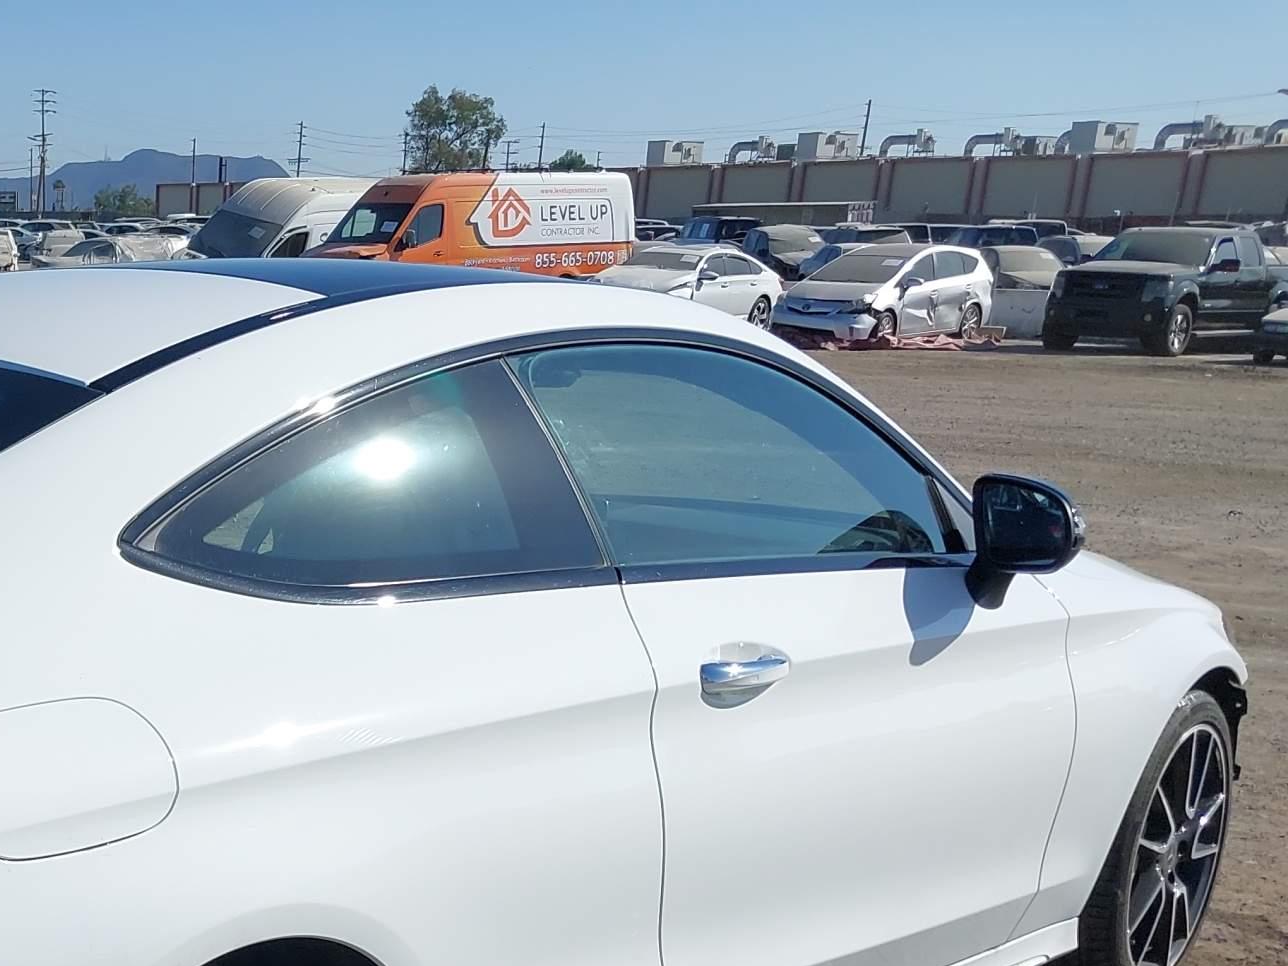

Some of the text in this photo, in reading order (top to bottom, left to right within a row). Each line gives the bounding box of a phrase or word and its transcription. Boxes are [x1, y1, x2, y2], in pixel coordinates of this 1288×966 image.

[540, 204, 608, 222] LEVEL UP
[540, 227, 585, 237] CONTRACTOR
[535, 251, 615, 268] 855-665-0708
